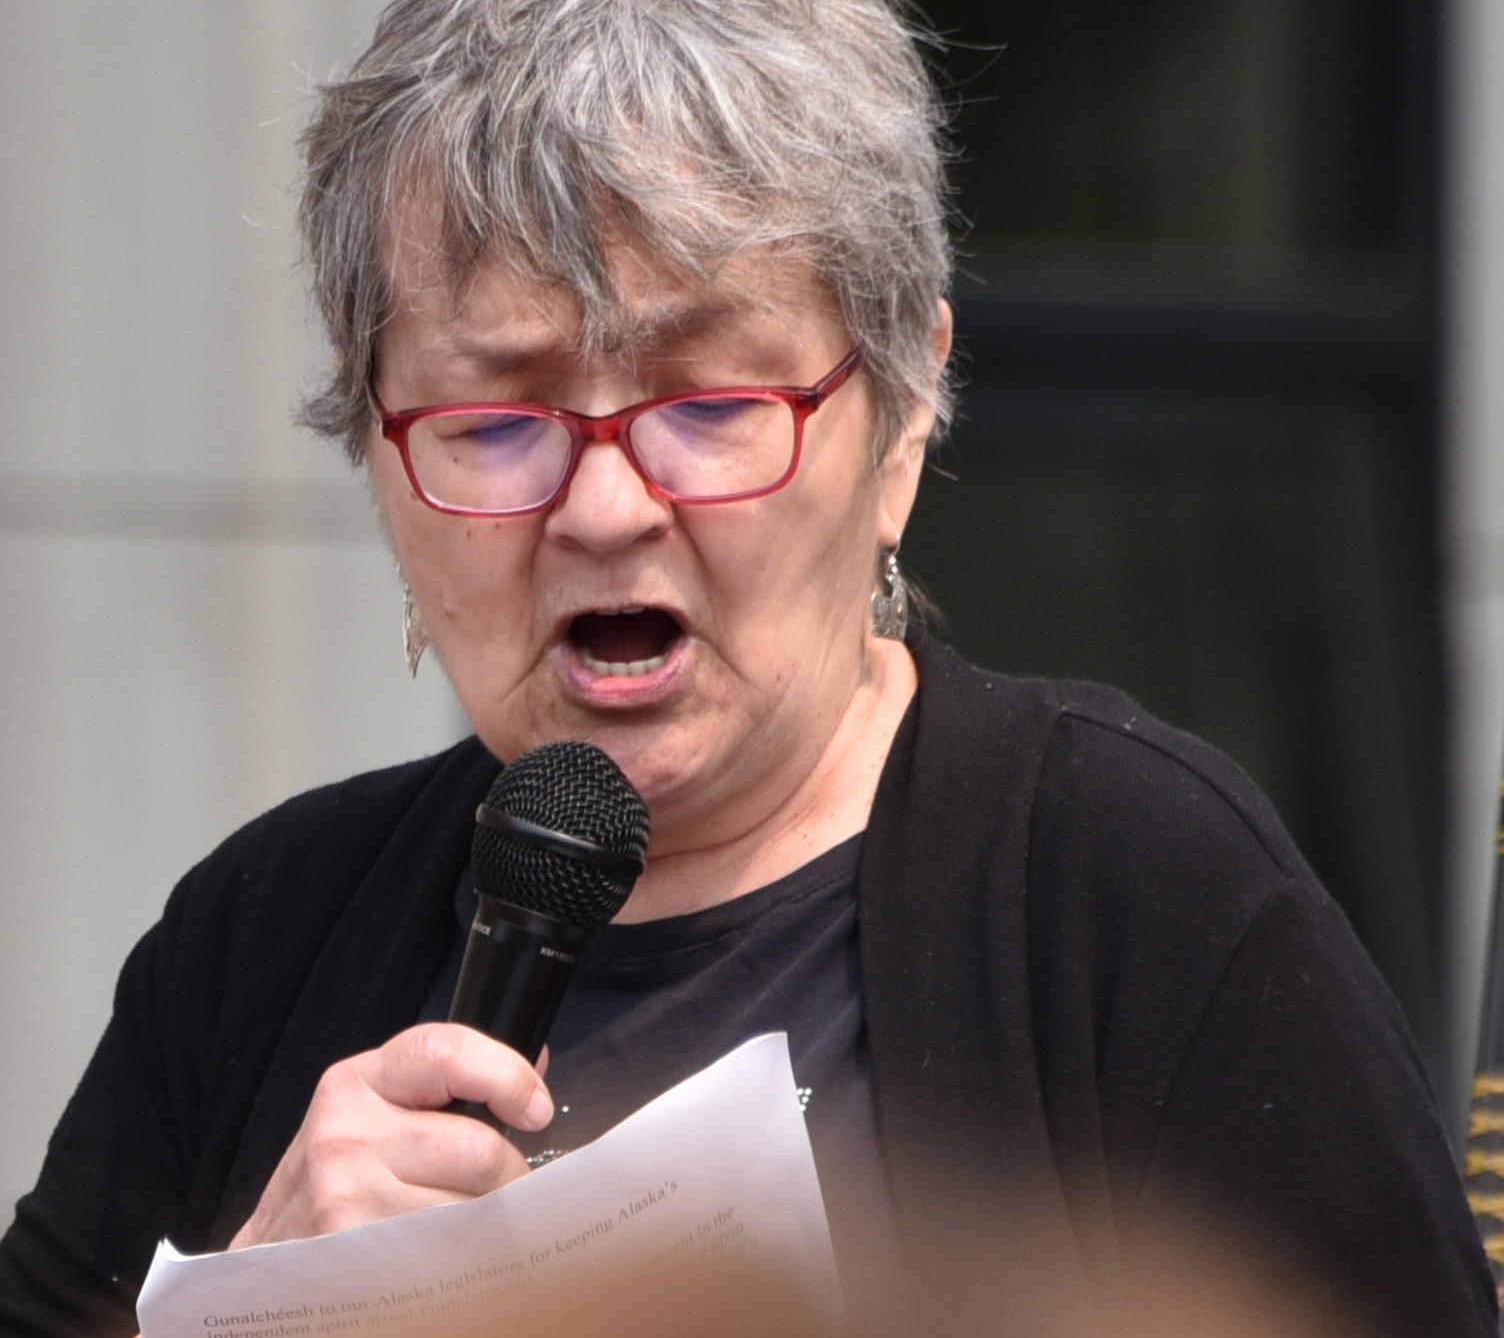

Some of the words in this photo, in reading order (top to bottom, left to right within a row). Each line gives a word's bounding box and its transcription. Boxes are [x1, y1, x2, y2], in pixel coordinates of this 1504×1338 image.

[713, 1207, 734, 1227] the
[319, 1304, 336, 1316] to
[341, 1300, 369, 1313] our
[376, 1286, 434, 1308] Alaska
[439, 1260, 525, 1294] legislators
[529, 1250, 551, 1267] for
[555, 1218, 614, 1255] keeping
[617, 1180, 679, 1224] Alaska's
[316, 1318, 360, 1335] spirit
